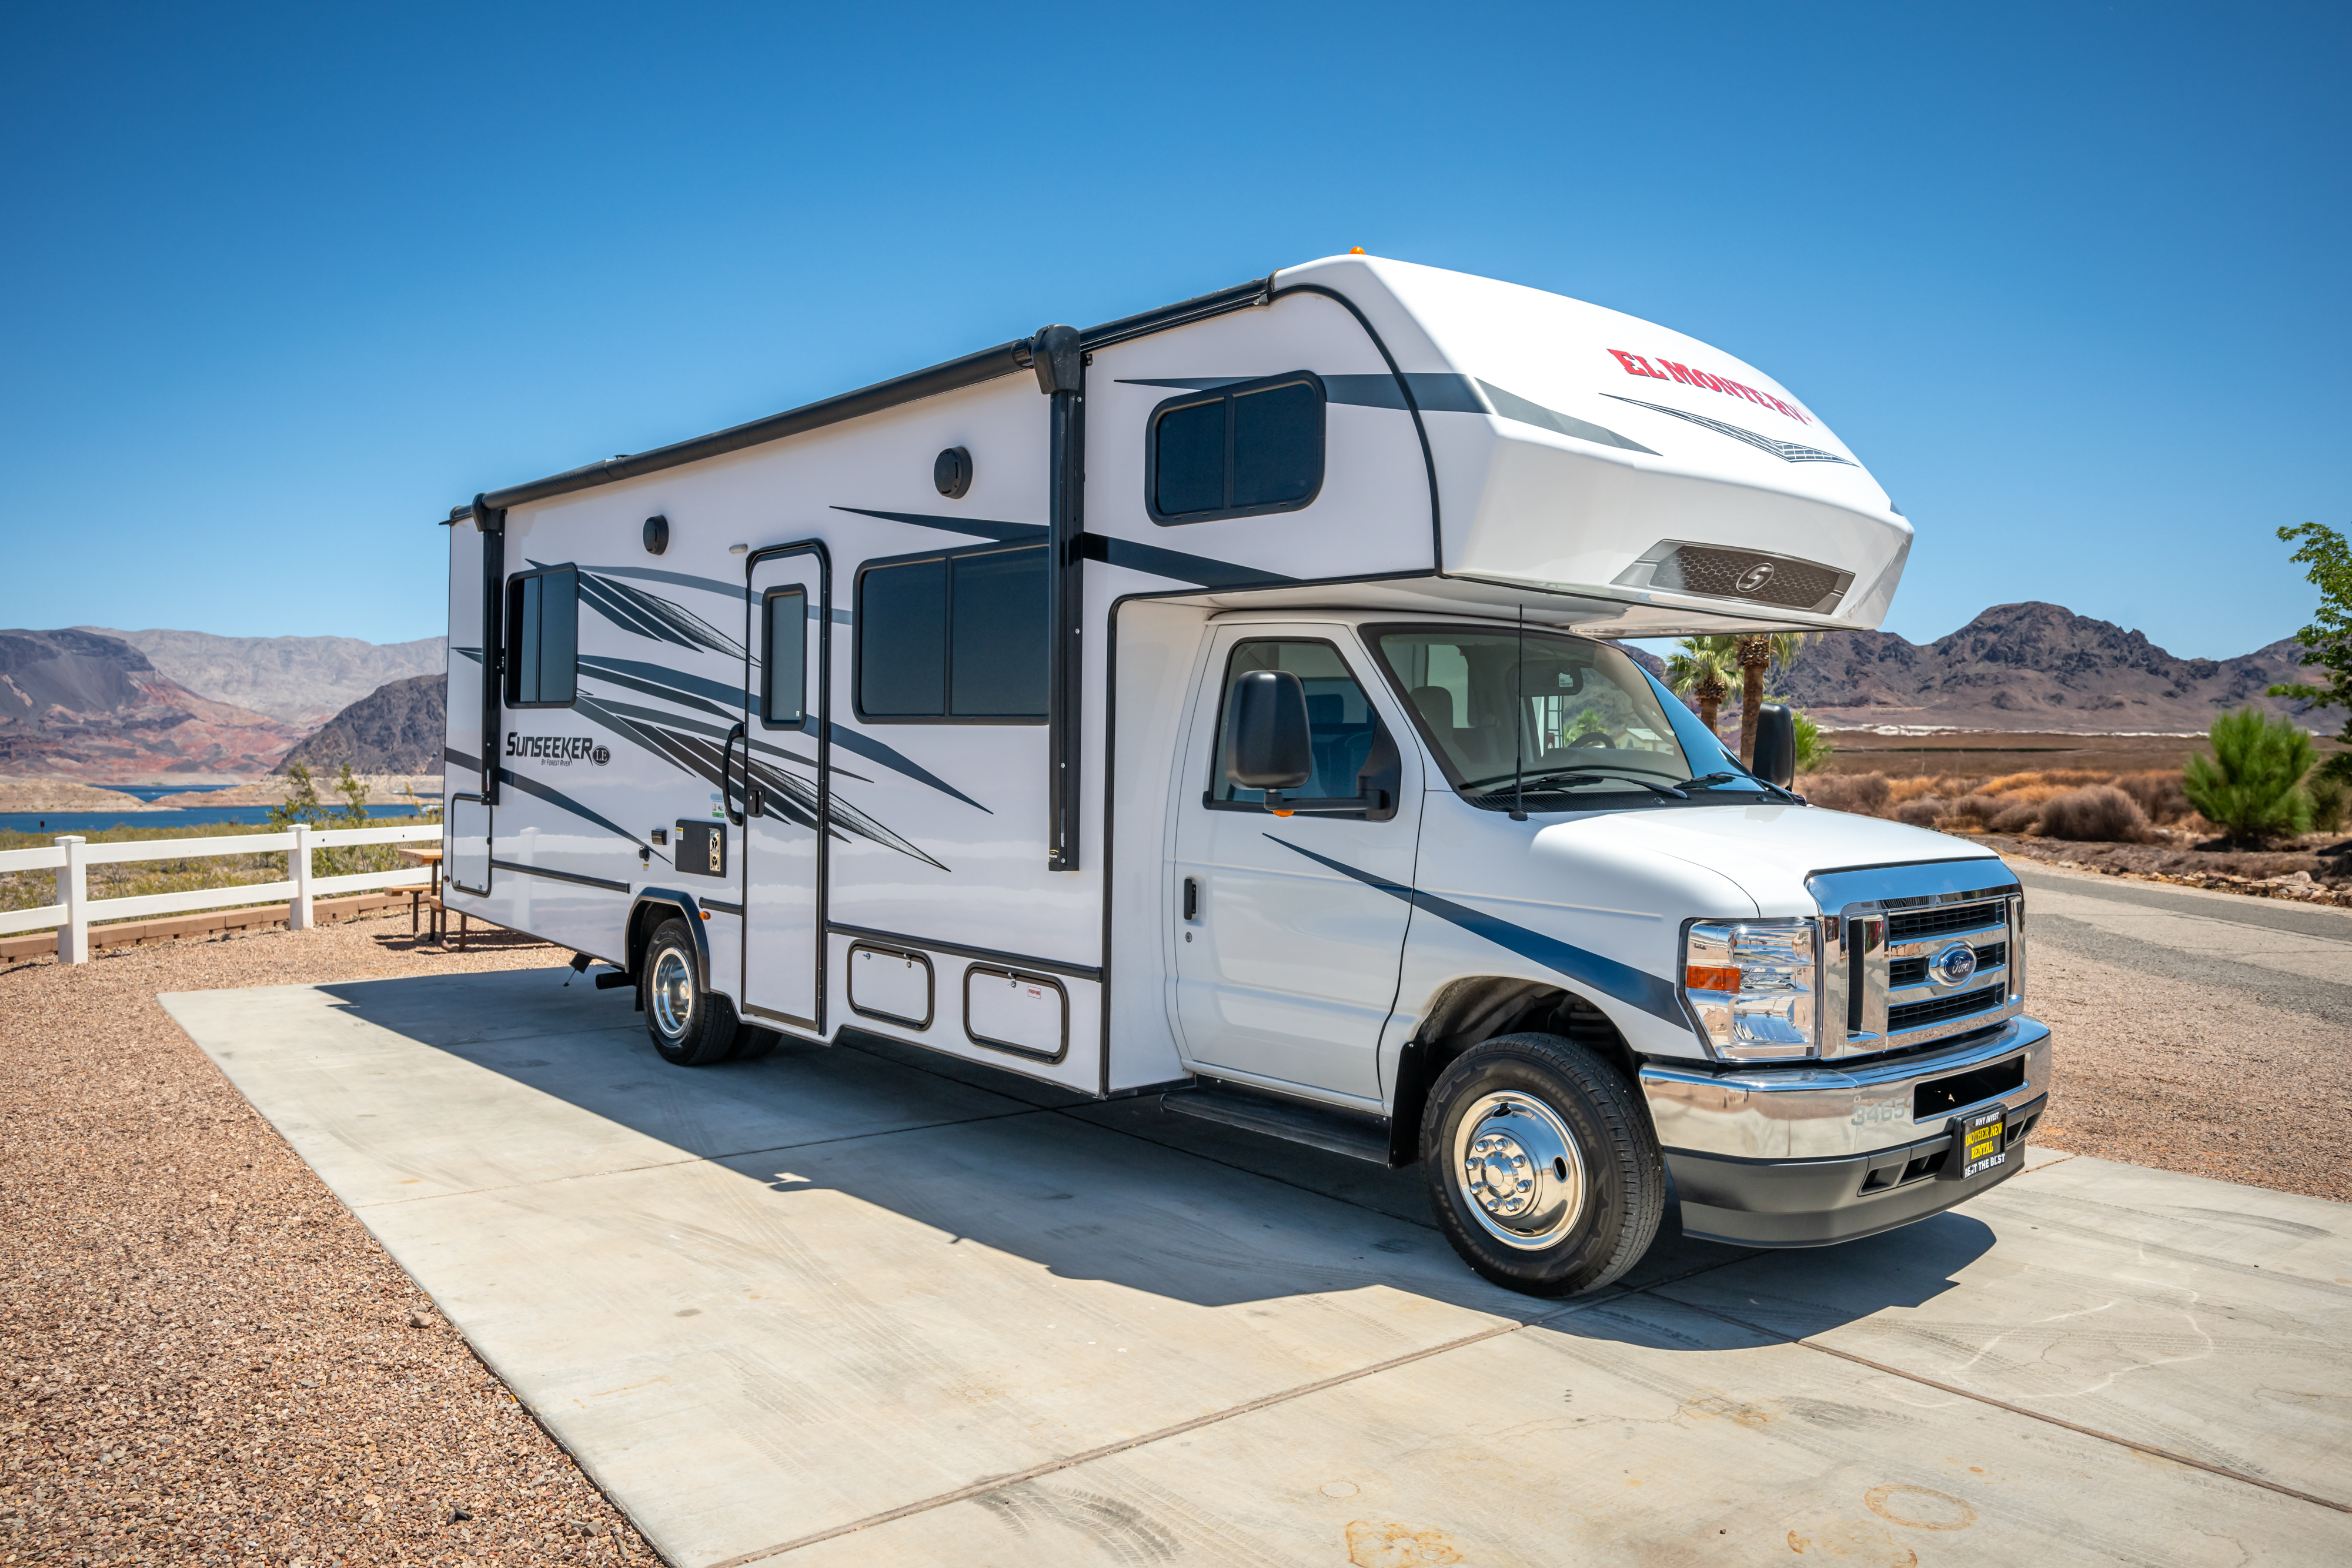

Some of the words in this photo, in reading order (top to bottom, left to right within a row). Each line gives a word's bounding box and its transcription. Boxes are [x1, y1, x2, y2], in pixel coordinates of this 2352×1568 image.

[1606, 348, 1671, 381] EL
[1655, 357, 1776, 411] MONTE
[506, 731, 593, 767] SUNSEEKER
[595, 749, 607, 761] LE
[1952, 955, 1970, 974] Ford
[1975, 1116, 1986, 1126] WHY
[1986, 1111, 2000, 1124] INVEST
[1965, 1126, 1990, 1147] ANOTHER
[1990, 1121, 2003, 1138] NEW
[1971, 1141, 1994, 1160] RENTAL
[1965, 1164, 1977, 1178] RENT
[1978, 1158, 1989, 1171] THE
[1990, 1153, 2006, 1167] BEST
